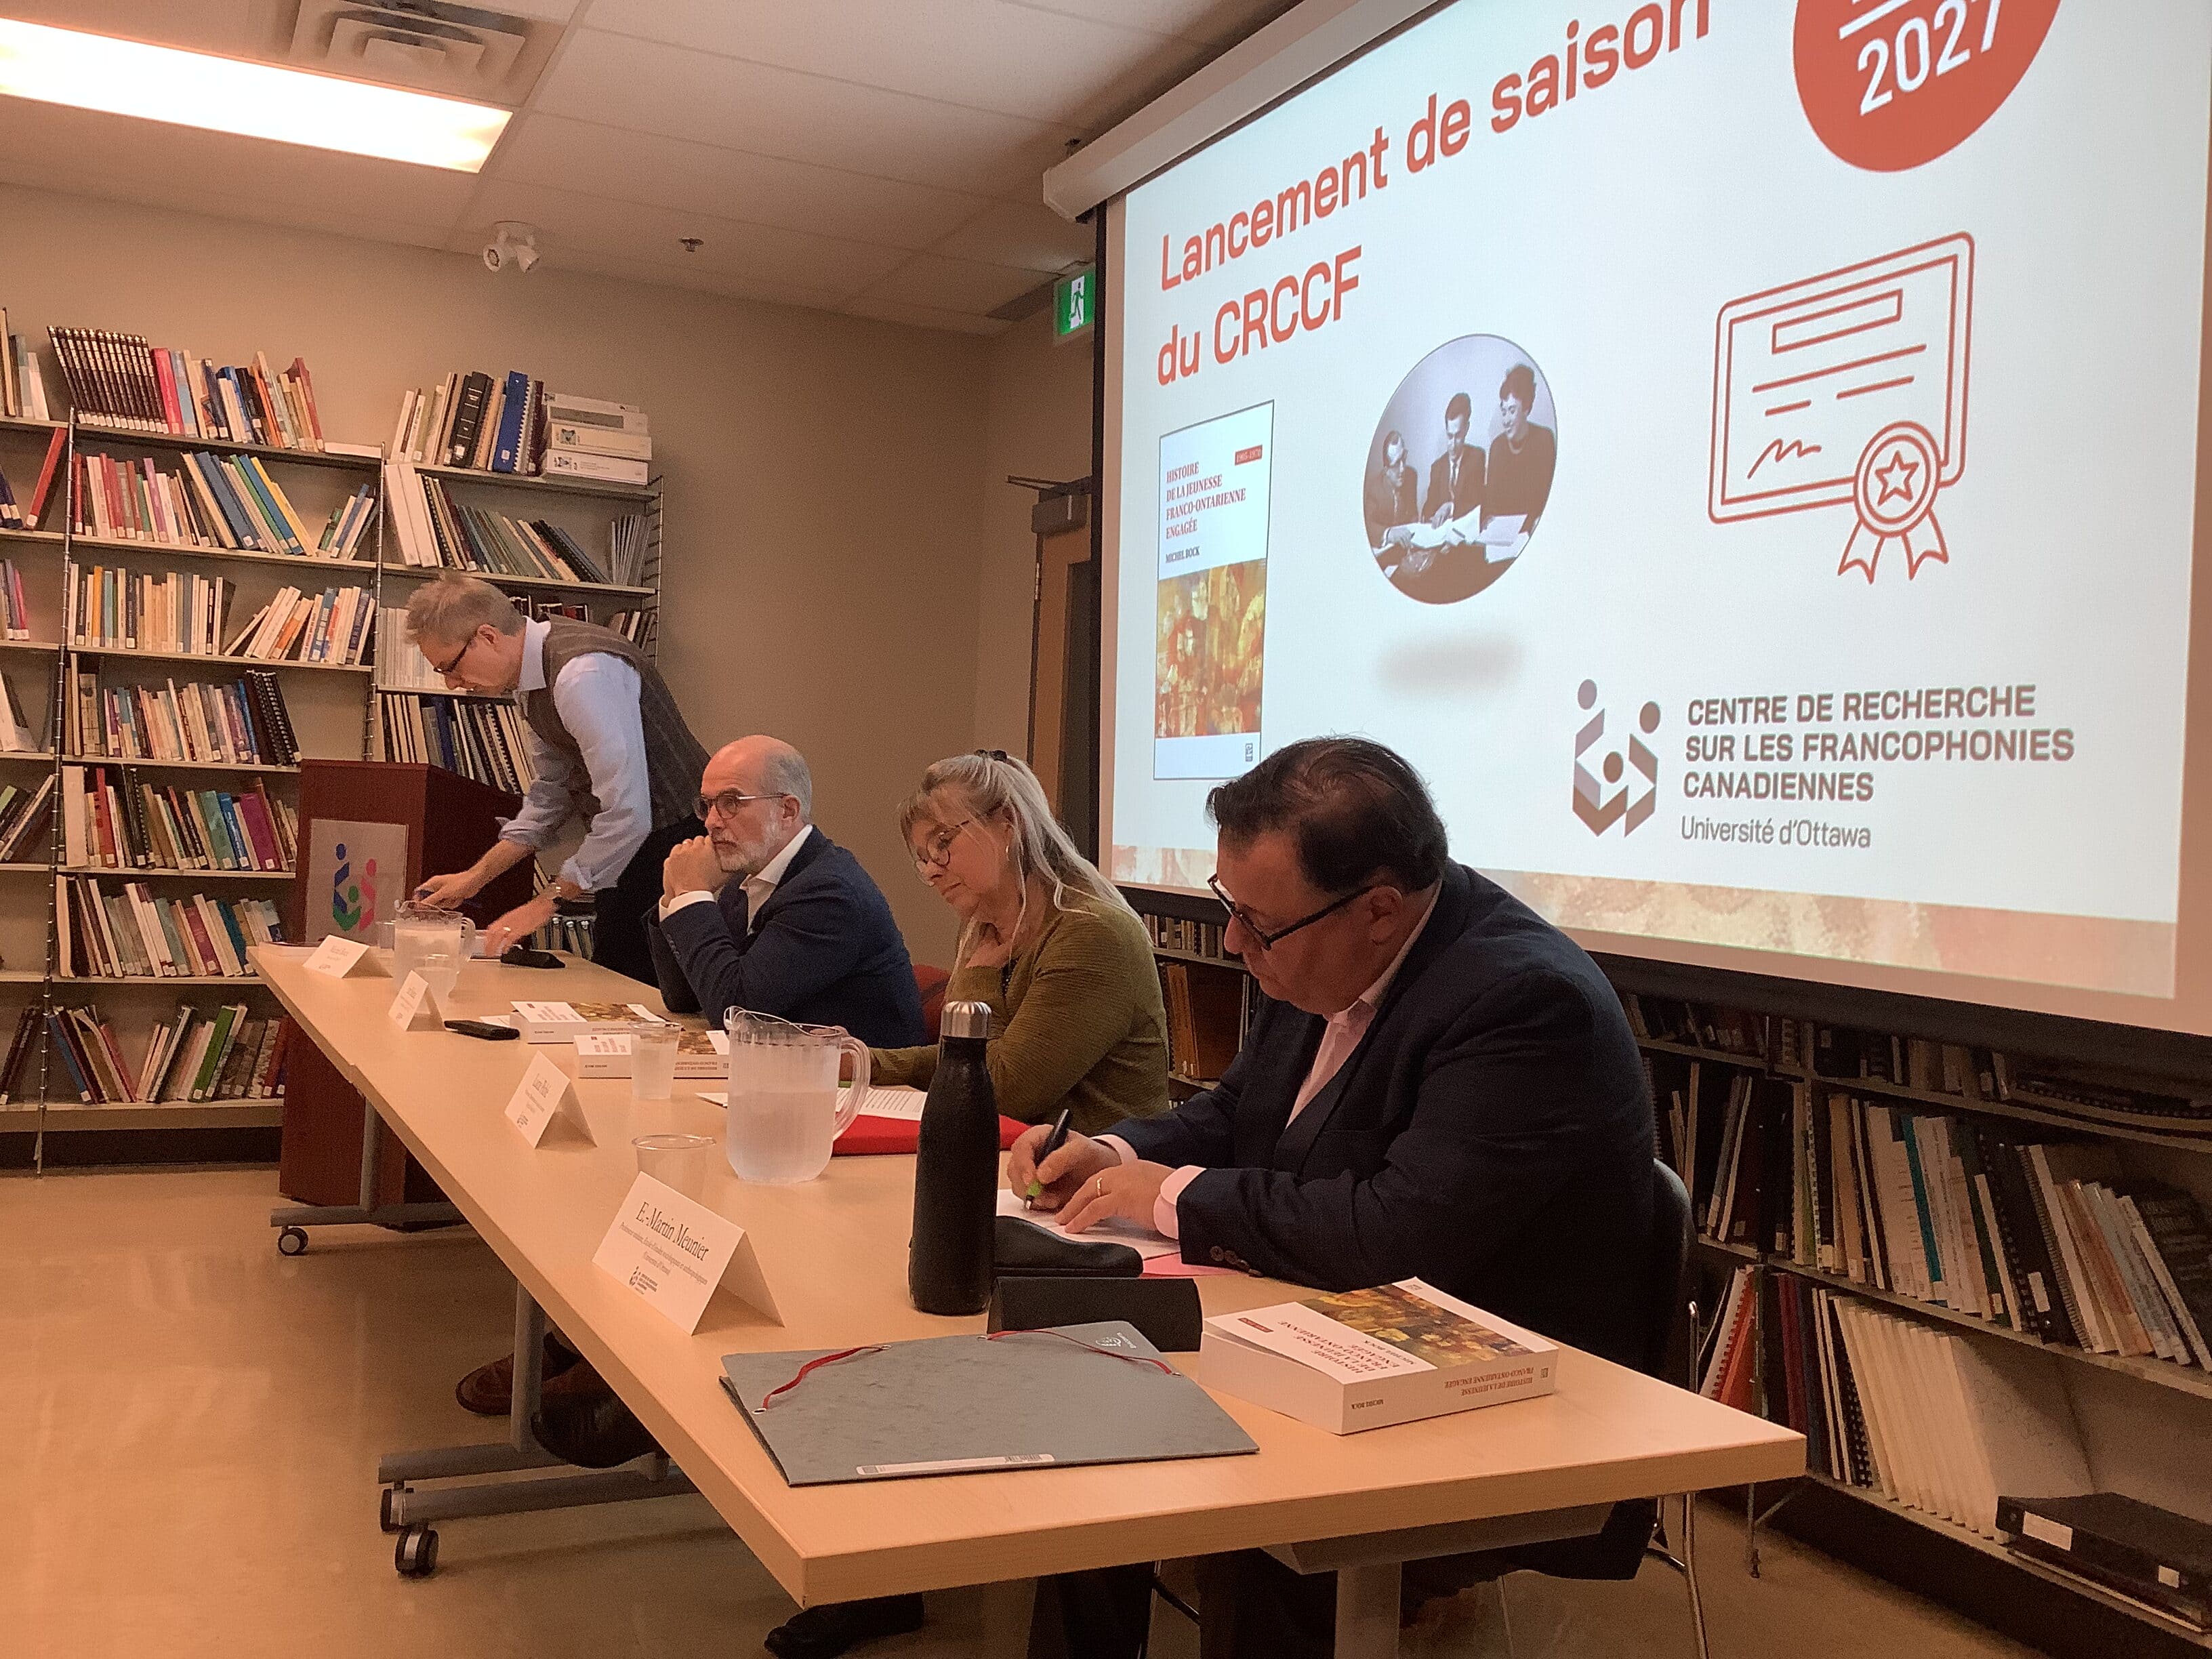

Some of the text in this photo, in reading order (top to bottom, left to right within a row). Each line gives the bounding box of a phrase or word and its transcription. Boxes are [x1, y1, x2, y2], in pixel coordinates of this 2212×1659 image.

[1858, 0, 2001, 116] 2027
[1162, 0, 1709, 291] Lancement de saison
[1158, 247, 1361, 386] du CRCCF
[1166, 462, 1199, 483] HISTOIRE
[1166, 474, 1223, 502] DE LA JEUNESSE
[1166, 488, 1246, 521] FRANCO-ONTARIENNE
[1166, 517, 1198, 539] ENGAGÉE
[1165, 546, 1200, 563] MICHEL BOCK
[1688, 684, 2036, 726] CENTRE DE RECHERCHE
[1685, 728, 2074, 762] SUR LES FRANCOPHONIES
[1683, 771, 1874, 802] CANADIENNES
[1681, 815, 1871, 848] Université d'Ottawa
[672, 1224, 710, 1261] Meunier
